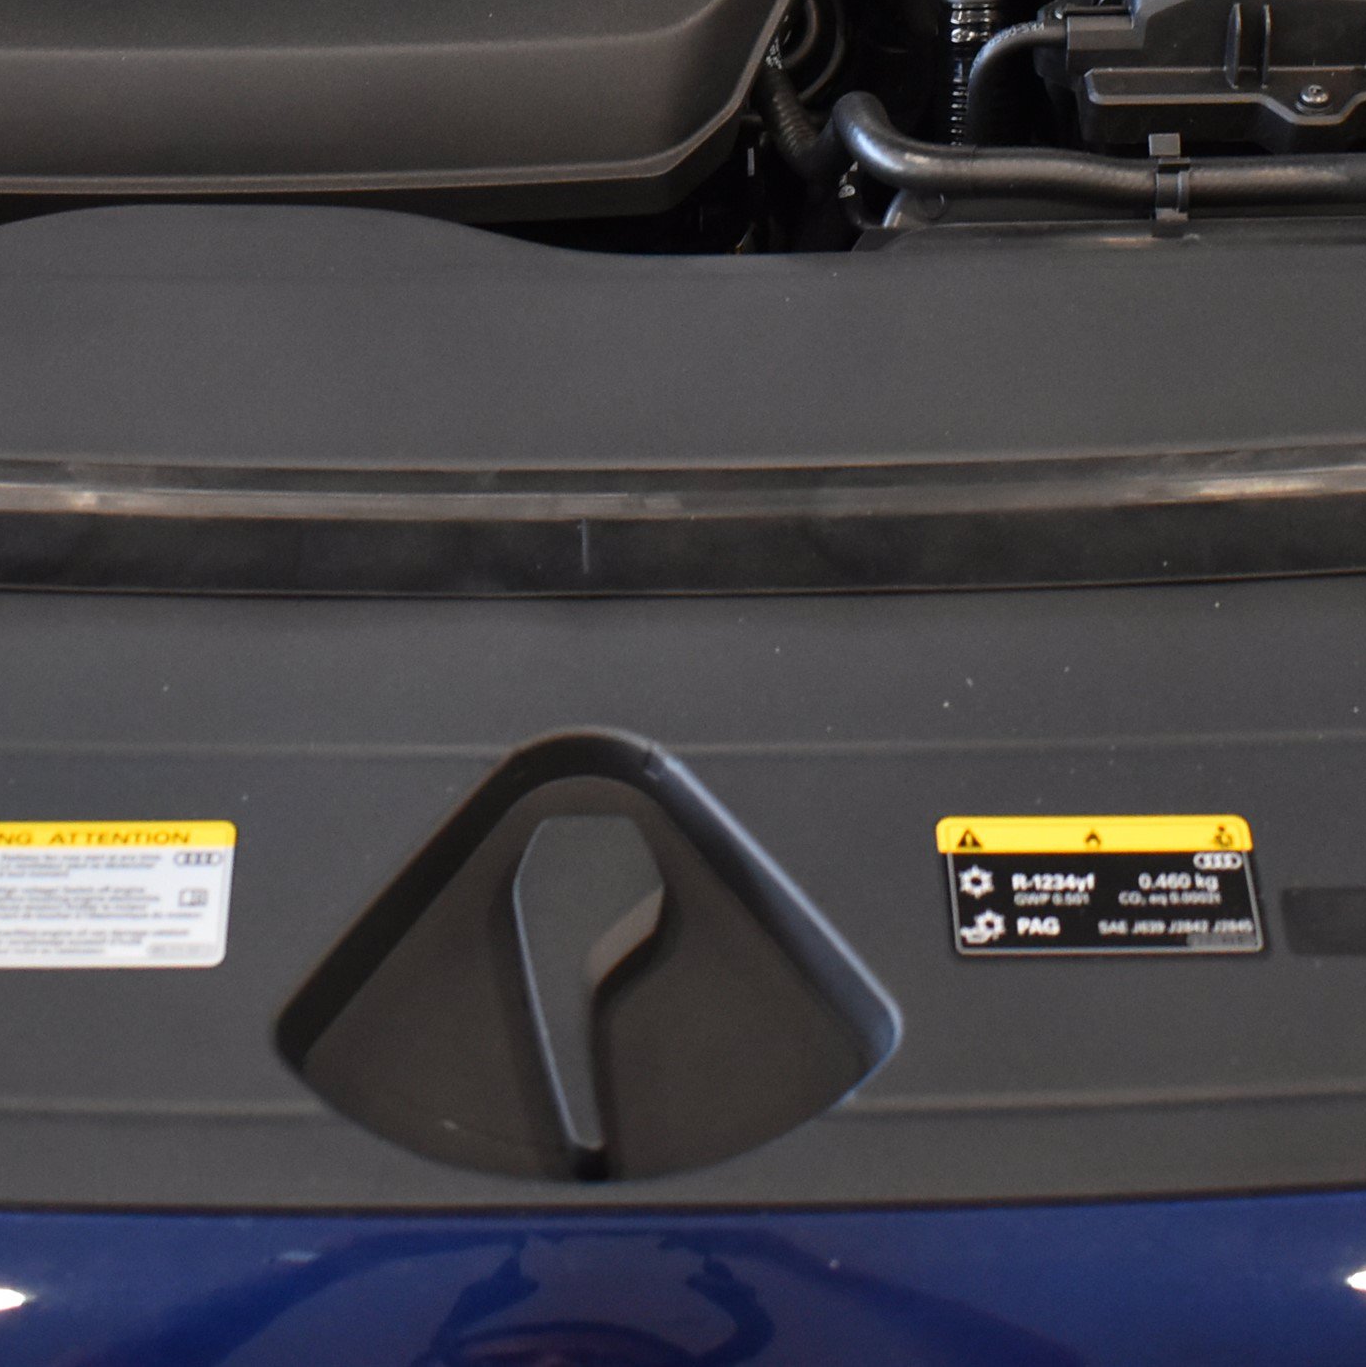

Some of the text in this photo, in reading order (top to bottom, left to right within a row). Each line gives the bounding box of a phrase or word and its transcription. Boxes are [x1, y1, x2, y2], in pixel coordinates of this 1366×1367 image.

[49, 831, 190, 845] ATTENTION
[1012, 873, 1095, 891] R-1234yf
[1194, 873, 1219, 892] kg
[1017, 916, 1060, 935] PAG
